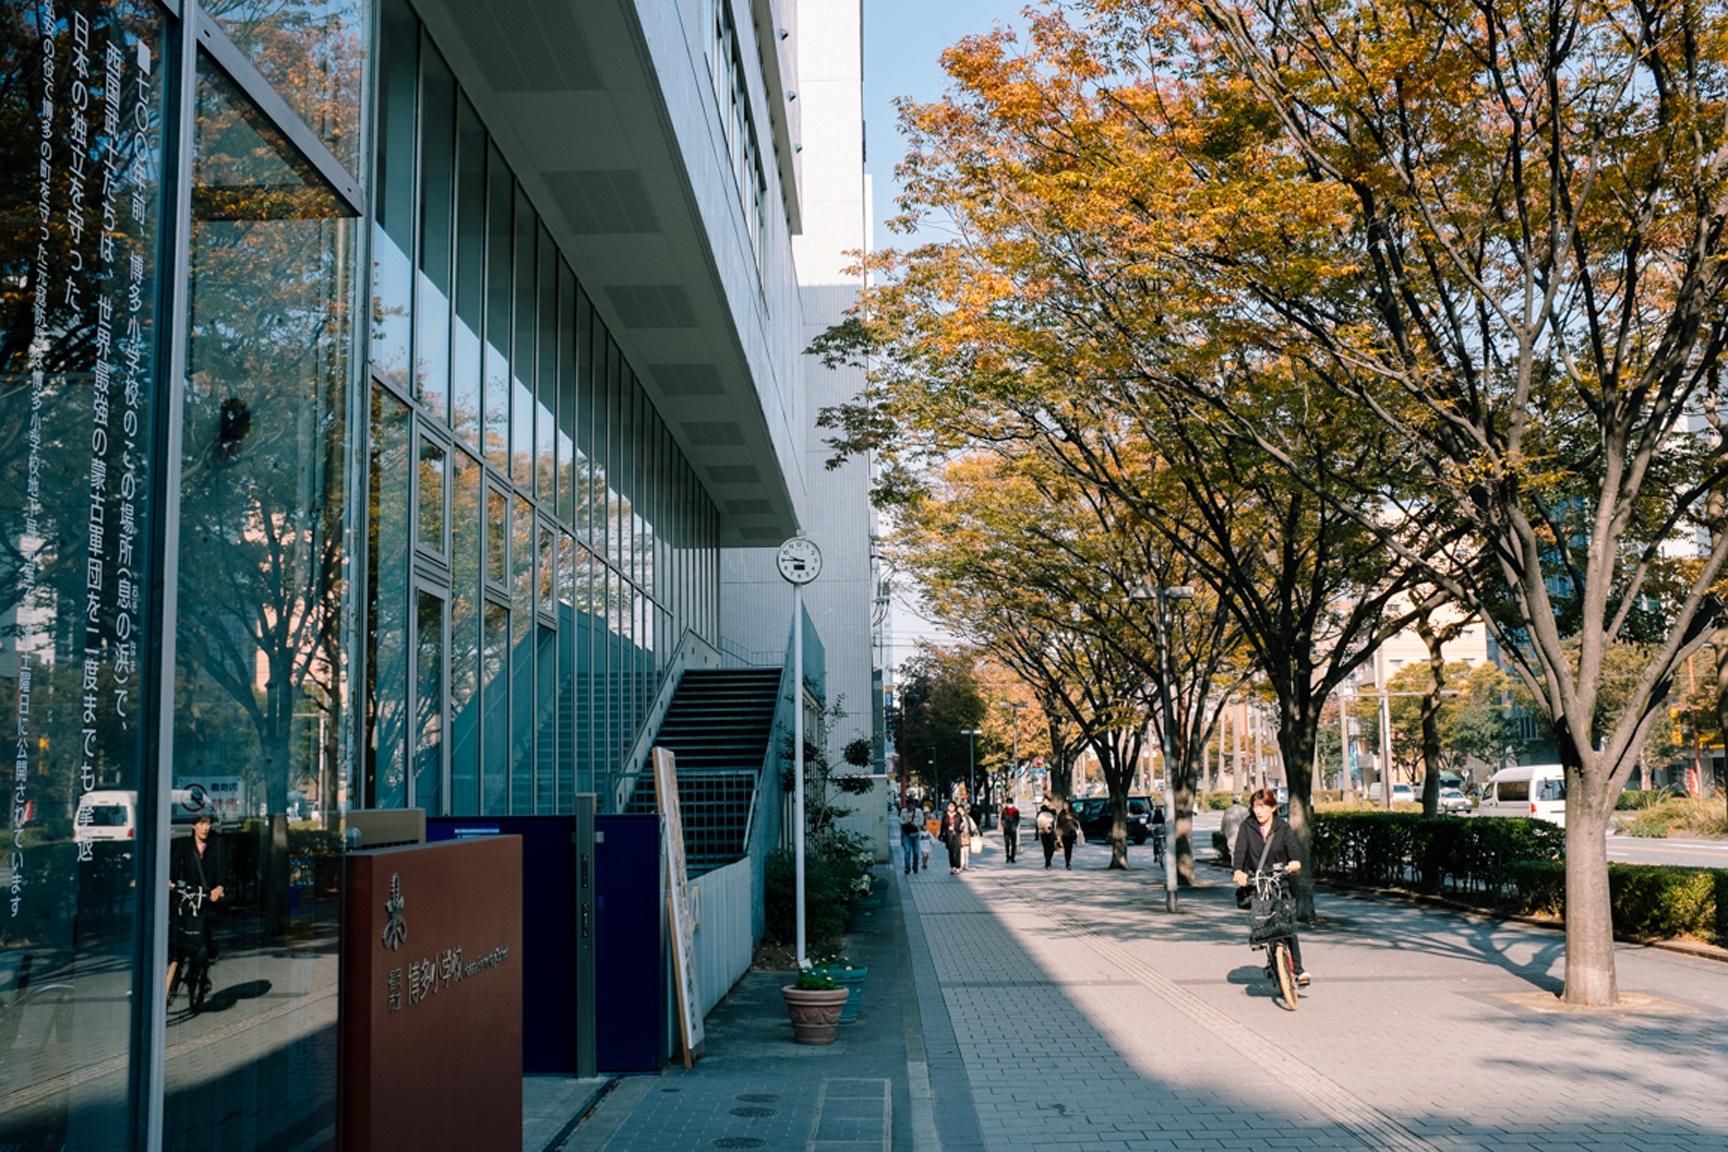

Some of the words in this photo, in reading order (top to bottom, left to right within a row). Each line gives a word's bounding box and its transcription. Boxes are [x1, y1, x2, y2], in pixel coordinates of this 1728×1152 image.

[64, 11, 90, 325] 日本の独立を守った。
[408, 945, 463, 1006] 博多小学校
